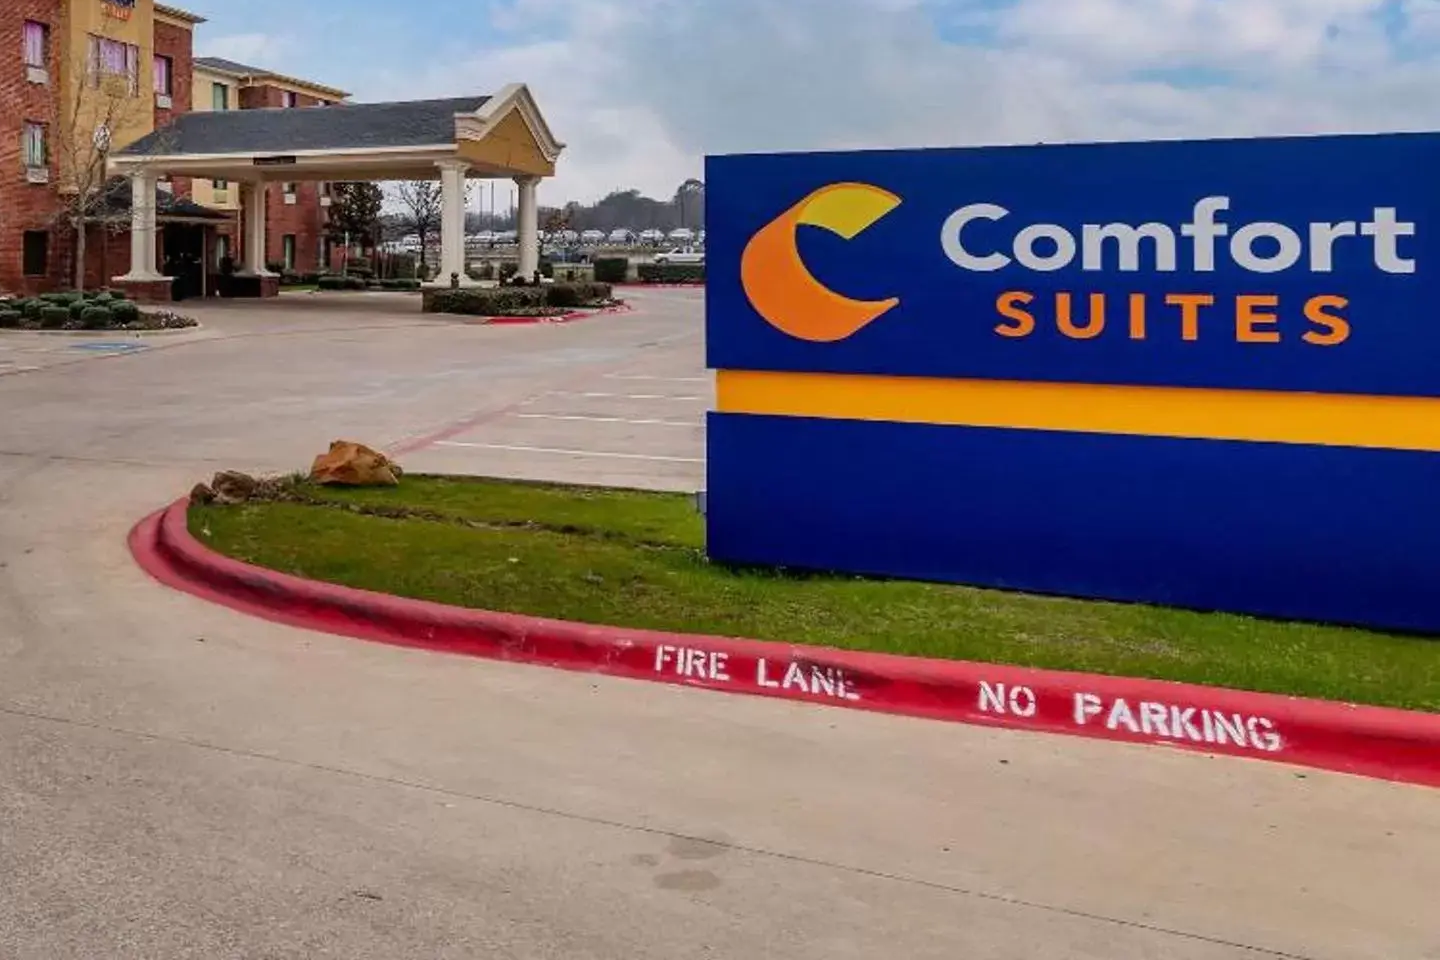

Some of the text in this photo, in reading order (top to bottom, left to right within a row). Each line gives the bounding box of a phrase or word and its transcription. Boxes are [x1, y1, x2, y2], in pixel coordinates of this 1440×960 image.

[940, 196, 1416, 274] Comfort
[993, 290, 1351, 346] SUITES
[655, 643, 1282, 752] FIRE LANE NO PARKING
